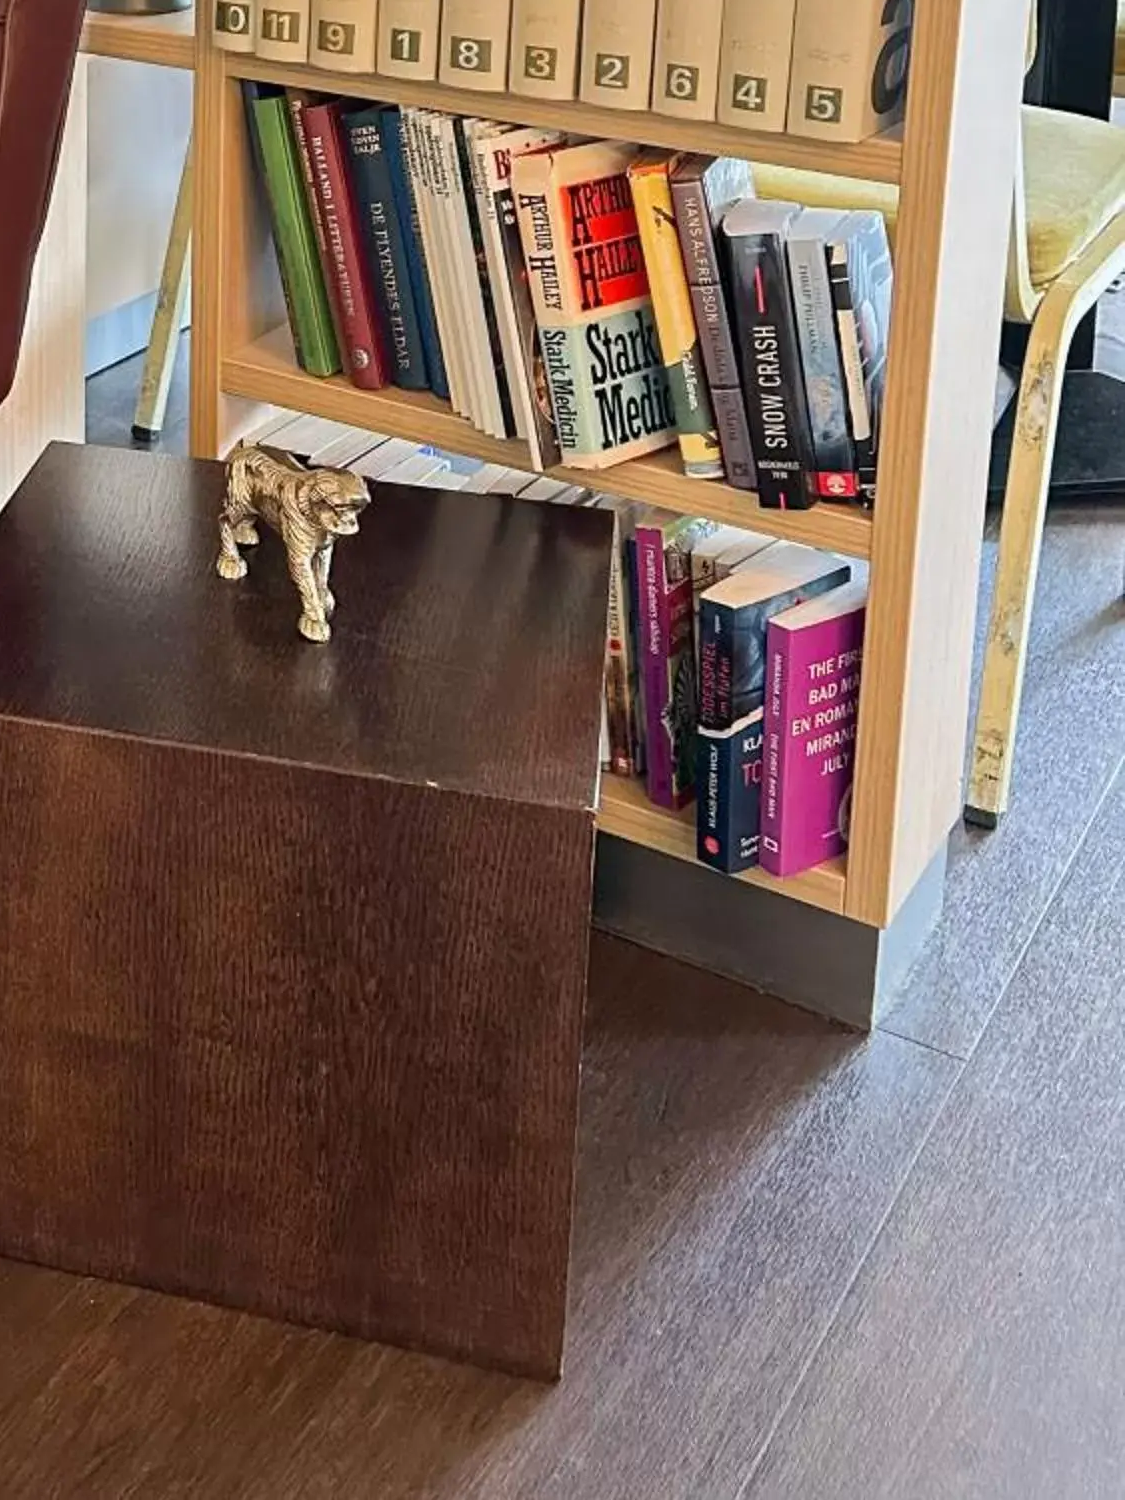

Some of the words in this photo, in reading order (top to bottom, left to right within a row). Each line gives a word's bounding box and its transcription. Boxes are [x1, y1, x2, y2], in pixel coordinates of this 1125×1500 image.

[266, 13, 291, 41] 11
[326, 24, 346, 51] 9
[396, 31, 410, 59] 1
[457, 39, 480, 69] 8
[527, 49, 551, 77] 3
[600, 57, 625, 87] 2
[670, 67, 694, 98] 6
[735, 79, 762, 109] 4
[810, 90, 836, 119] 5
[311, 135, 334, 200] HALLAND
[370, 202, 384, 226] DE
[518, 191, 554, 252] ARTHUR
[684, 197, 704, 236] HANS
[374, 229, 401, 312] FLYENDES
[528, 253, 564, 314] HAILEY
[689, 237, 719, 322] ALFREDSON
[390, 314, 410, 370] ELDAR
[542, 328, 568, 375] Stark
[586, 311, 661, 385] Stark
[752, 325, 782, 388] CRASH
[550, 375, 576, 449] Medicin
[760, 395, 788, 450] SNOW
[807, 657, 835, 680] THE
[808, 683, 838, 705] BAD
[791, 717, 812, 737] EN
[819, 754, 850, 776] JULY
